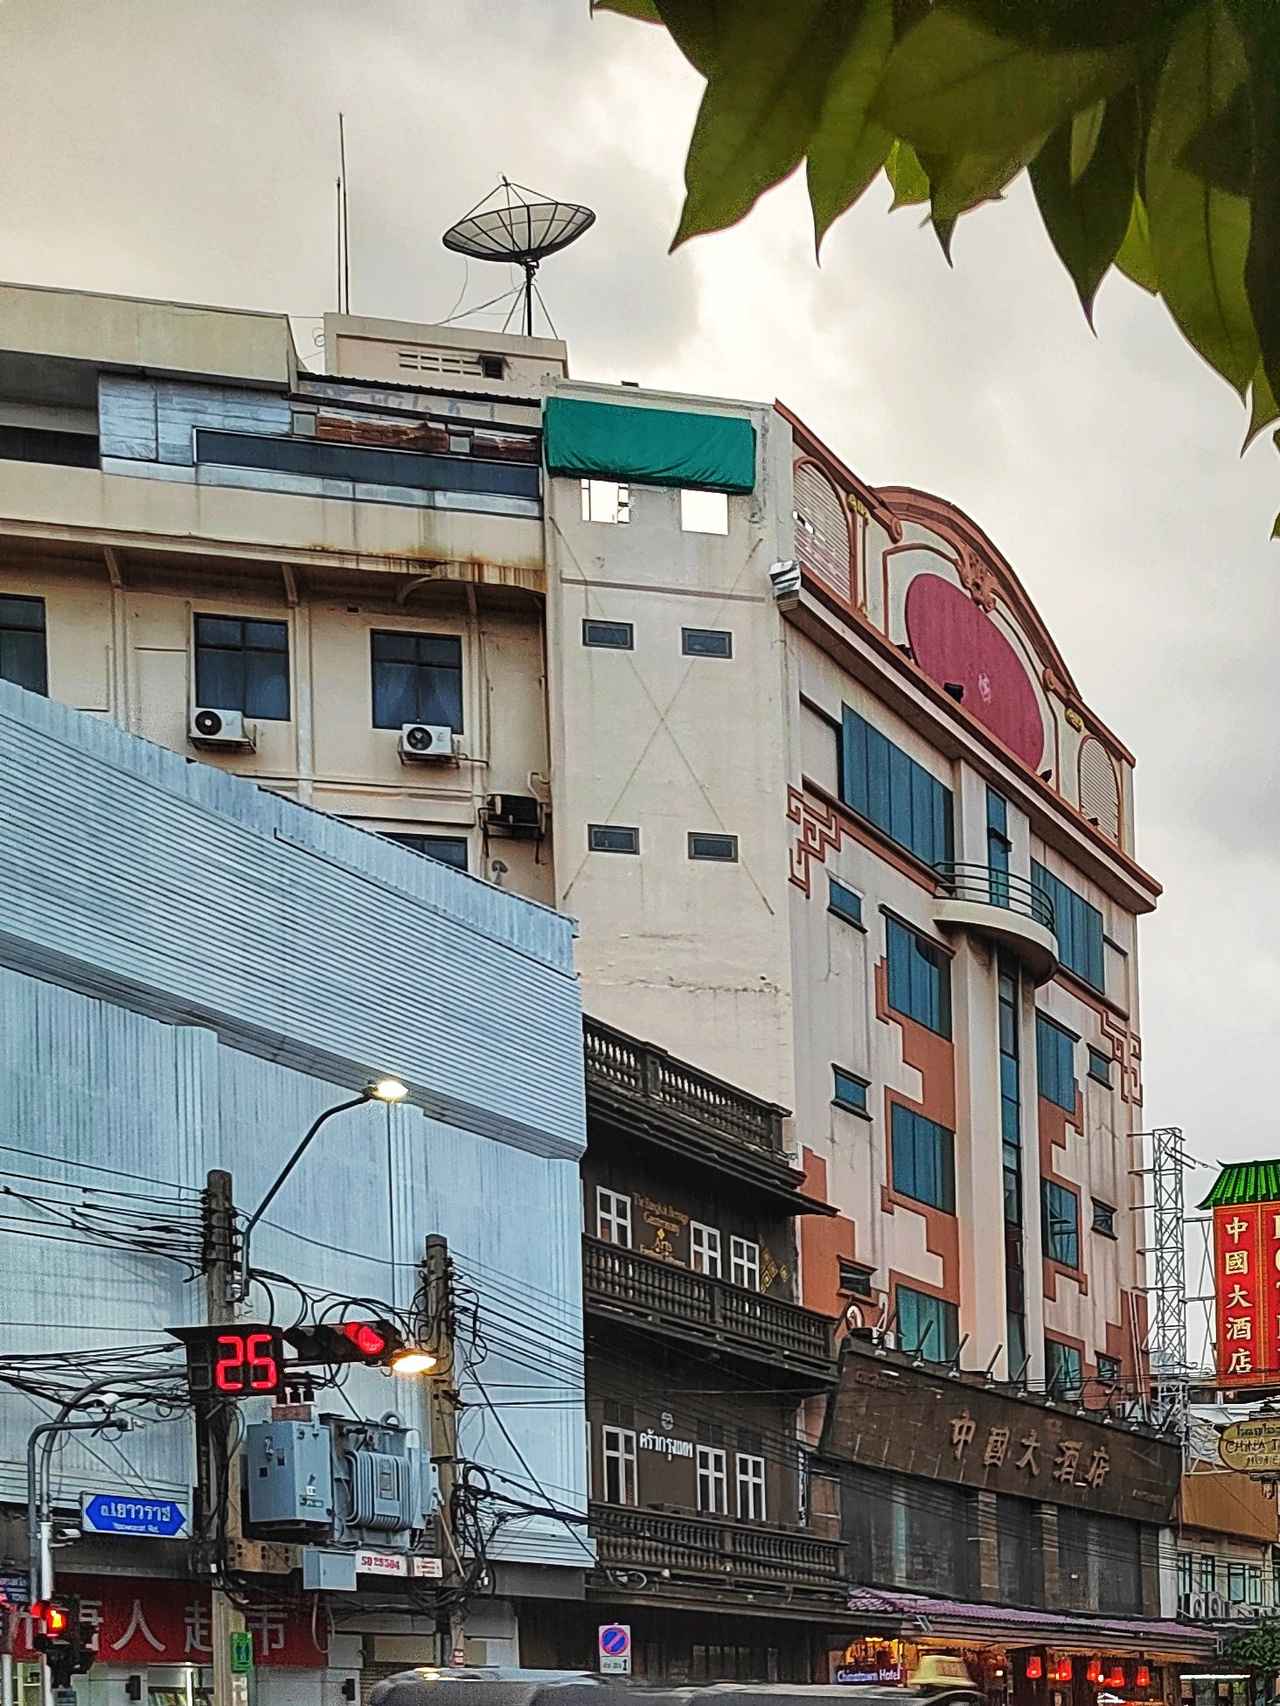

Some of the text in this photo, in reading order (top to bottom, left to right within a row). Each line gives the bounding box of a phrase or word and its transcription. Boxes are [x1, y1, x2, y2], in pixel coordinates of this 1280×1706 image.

[1225, 1216, 1253, 1374] 中國大酒店
[216, 1334, 277, 1390] 25
[880, 1668, 900, 1680] Hotel
